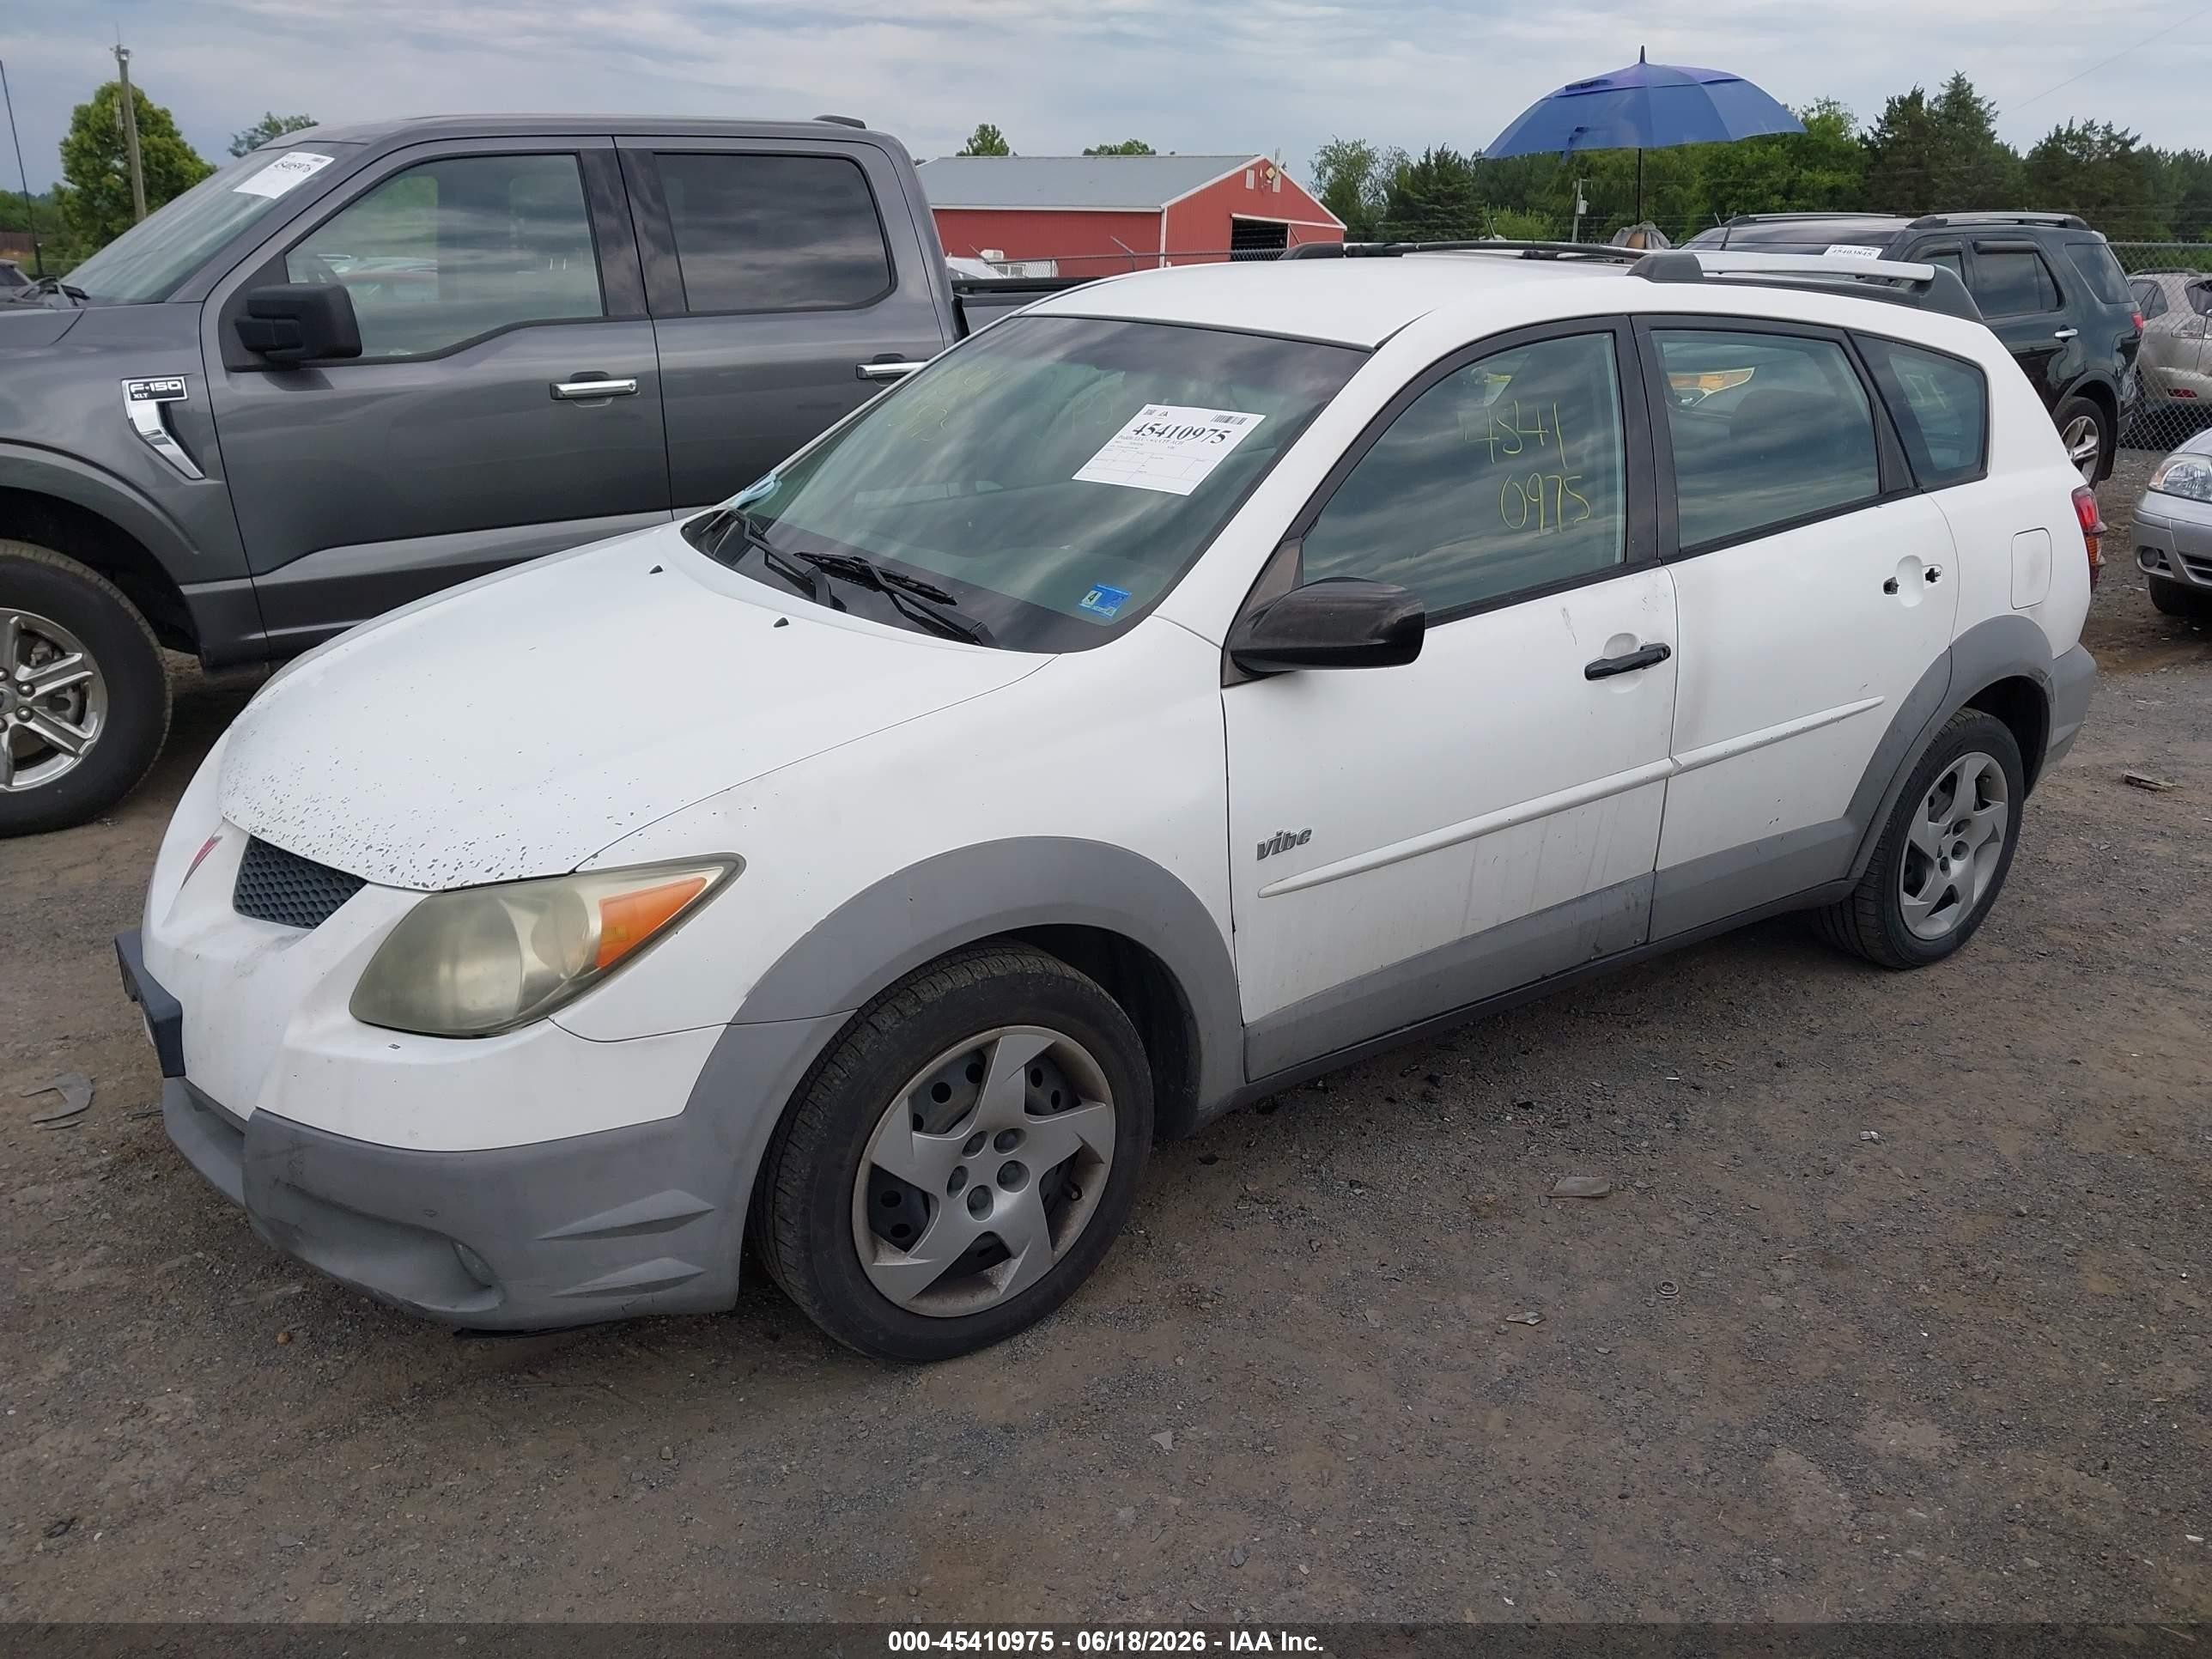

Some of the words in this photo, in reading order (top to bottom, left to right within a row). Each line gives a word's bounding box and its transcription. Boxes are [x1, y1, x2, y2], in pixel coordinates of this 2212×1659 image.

[130, 380, 182, 393] F-150
[1132, 422, 1232, 444] 45410975
[1501, 472, 1590, 534] 0975
